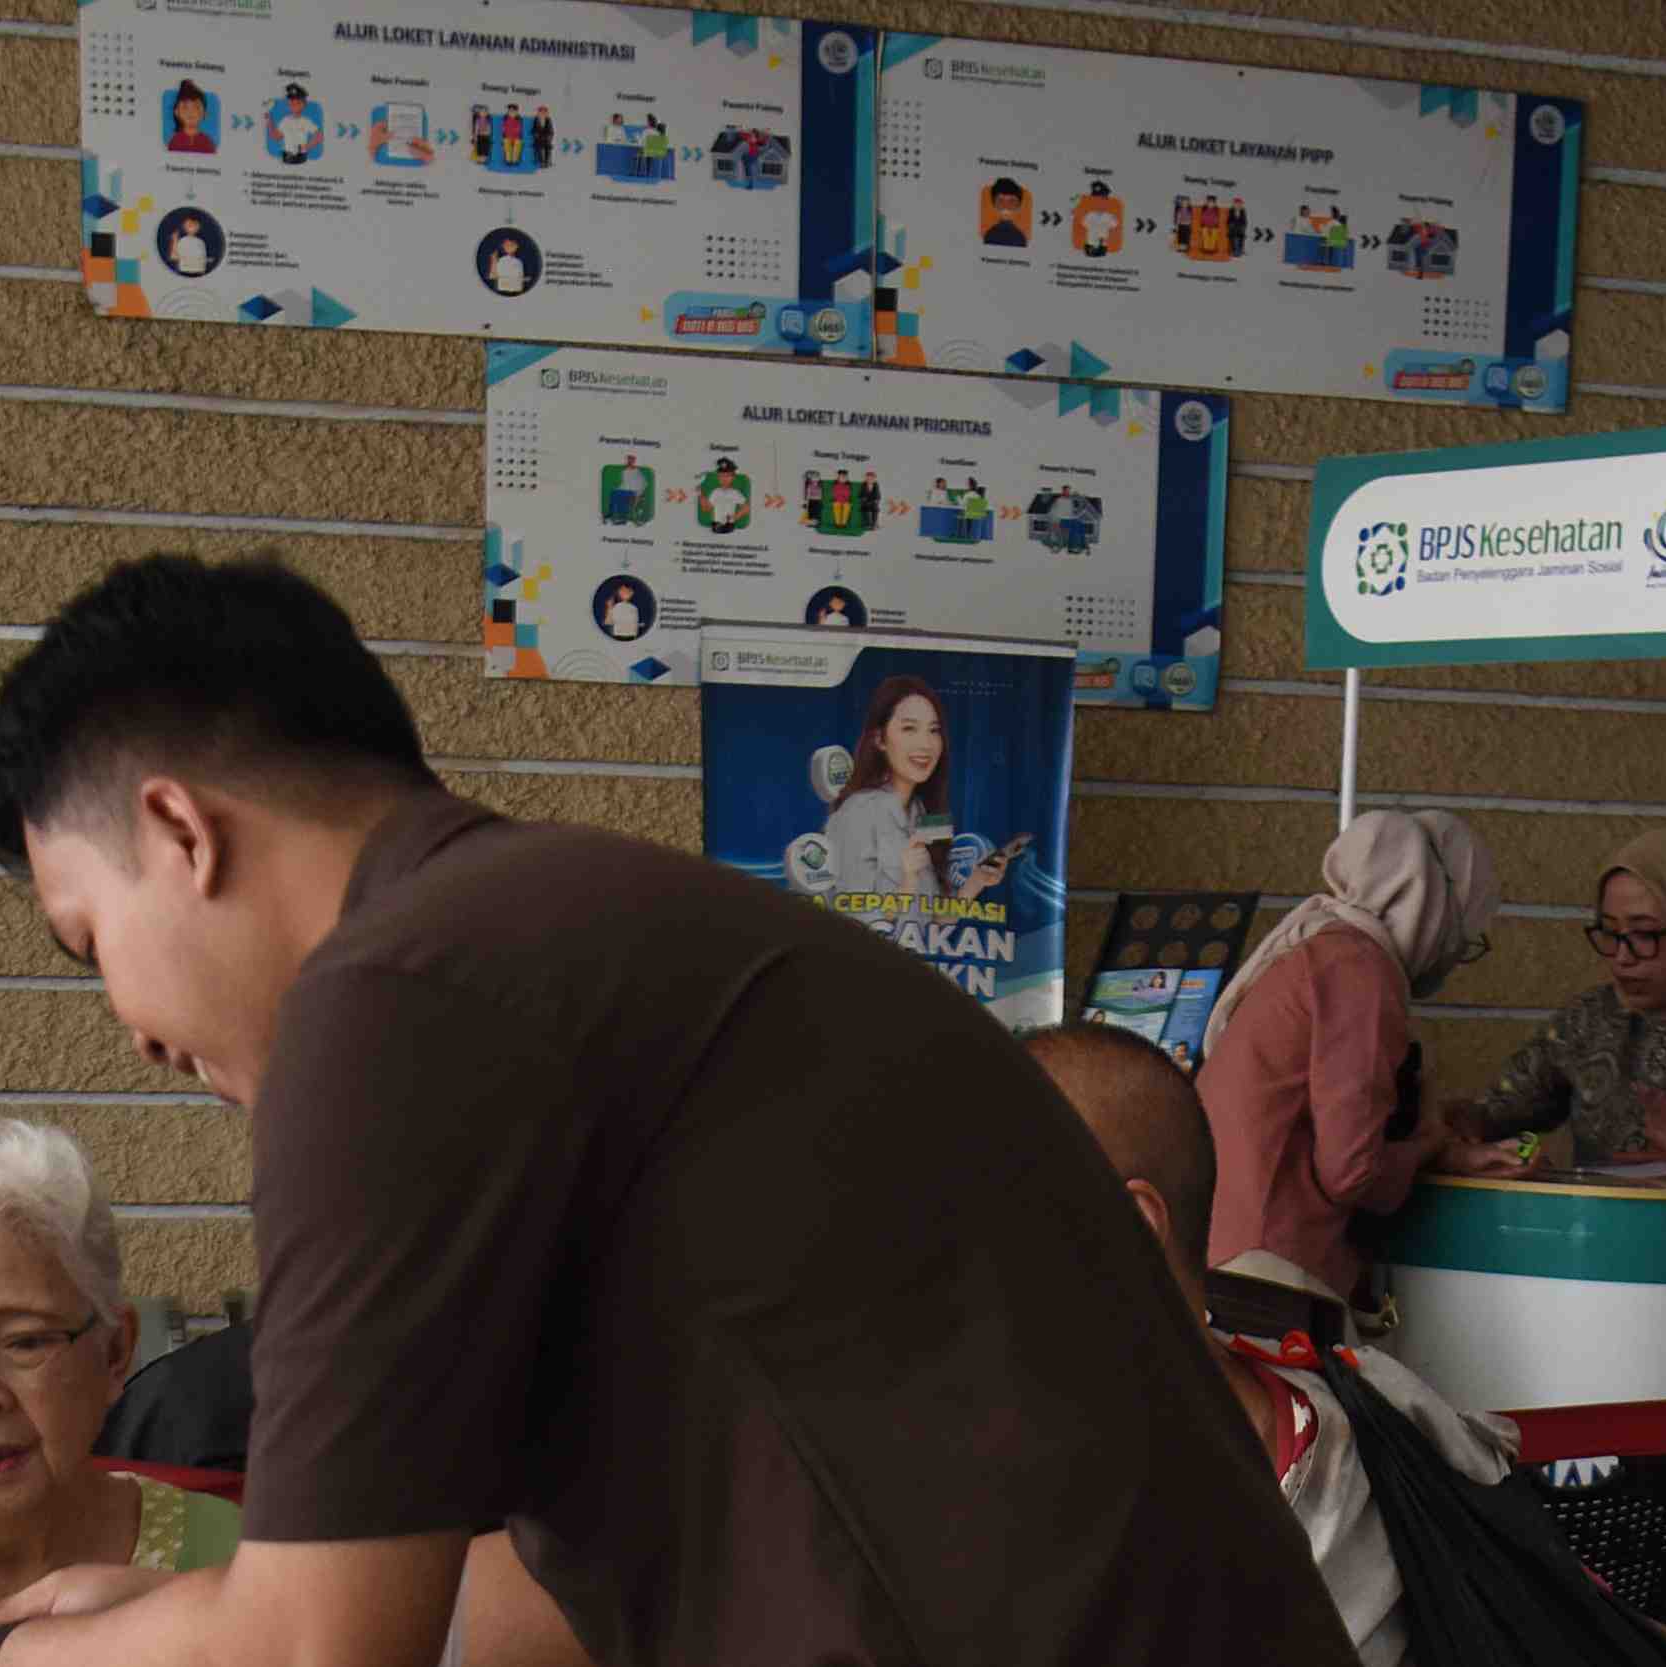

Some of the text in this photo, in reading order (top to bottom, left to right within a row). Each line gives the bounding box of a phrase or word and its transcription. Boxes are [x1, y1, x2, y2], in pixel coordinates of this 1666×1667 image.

[333, 23, 637, 62] ALUR LOKET LAYANAN ADMINISTRASI
[1137, 132, 1177, 150] ALUR
[1180, 136, 1227, 155] LOKET
[1230, 141, 1297, 161] LAYANAN
[741, 405, 992, 436] ALUR LOKET LAYANAN PRIORITAS
[1419, 518, 1623, 561] BPJS Kesehatan
[834, 894, 913, 913] CEPAT
[920, 896, 1006, 922] LUNASI
